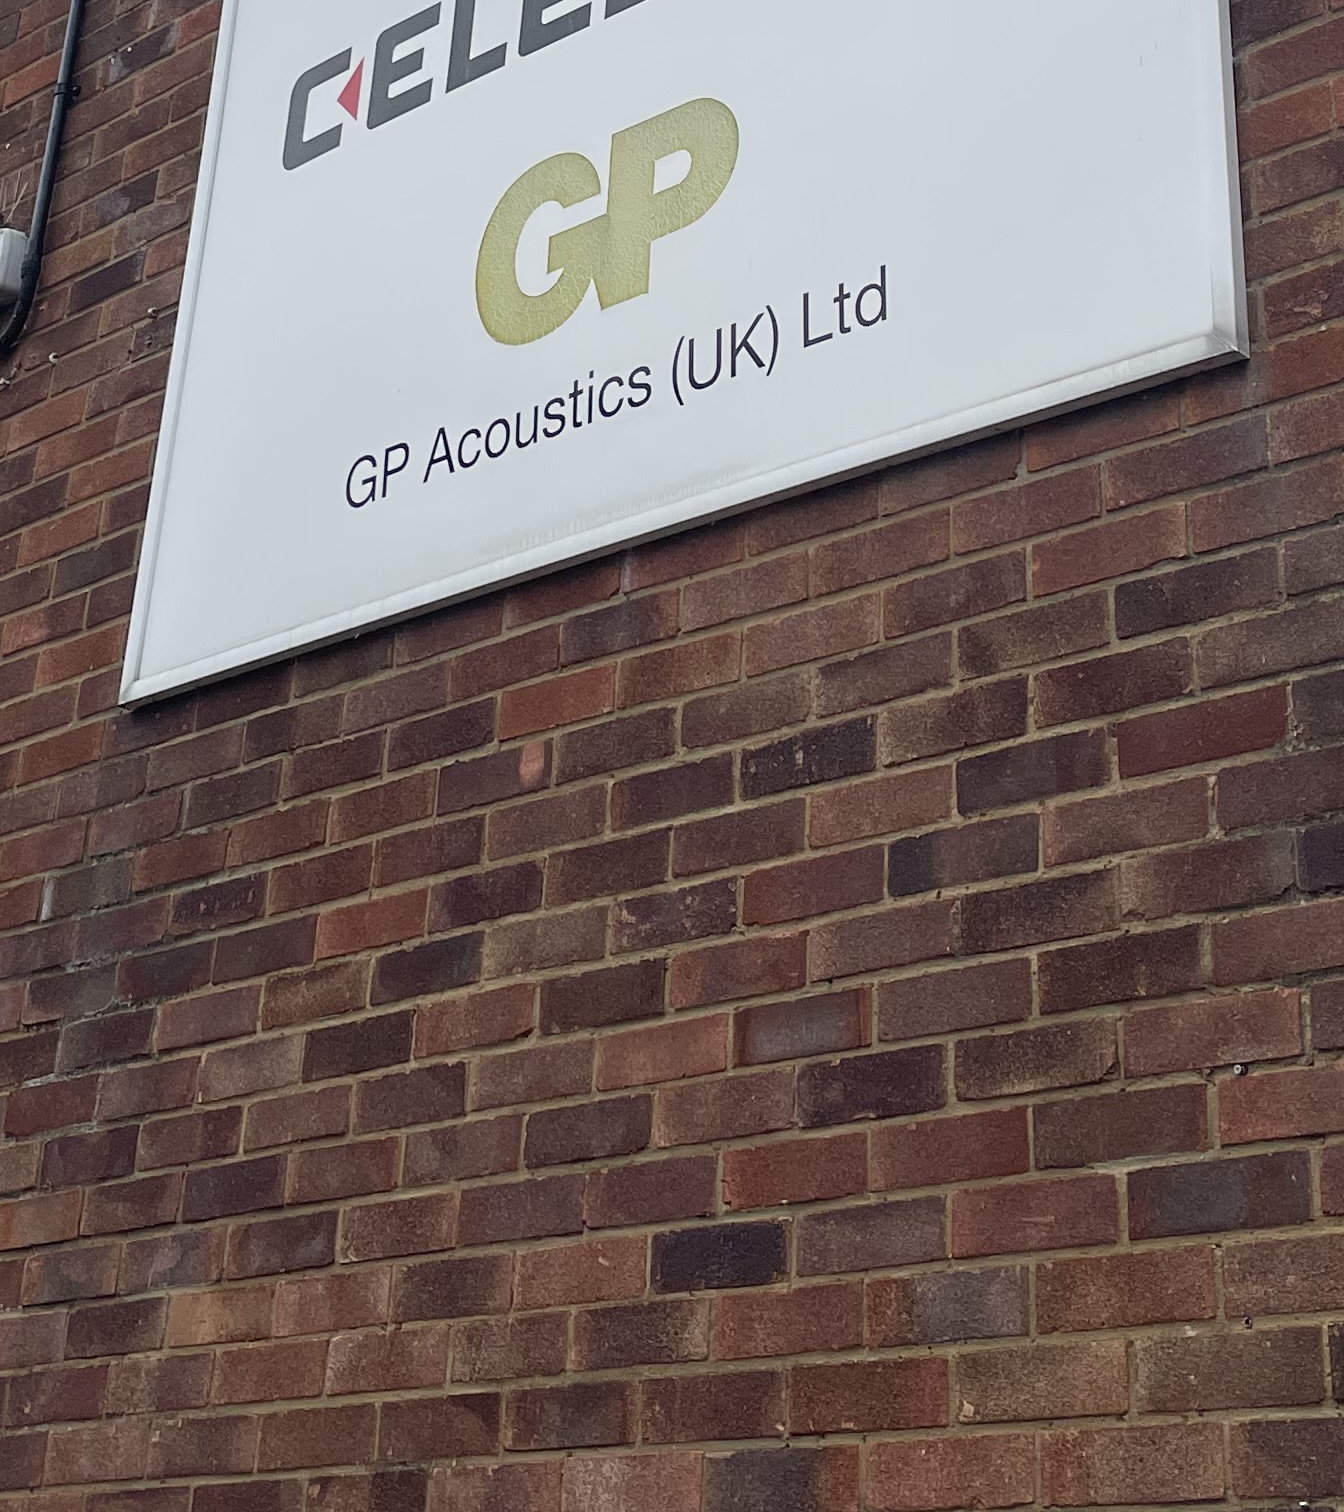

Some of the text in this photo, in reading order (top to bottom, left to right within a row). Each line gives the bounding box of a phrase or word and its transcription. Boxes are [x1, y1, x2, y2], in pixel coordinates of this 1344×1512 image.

[474, 96, 741, 347] GP
[344, 263, 888, 509] GP Acoustics (UK) Ltd
